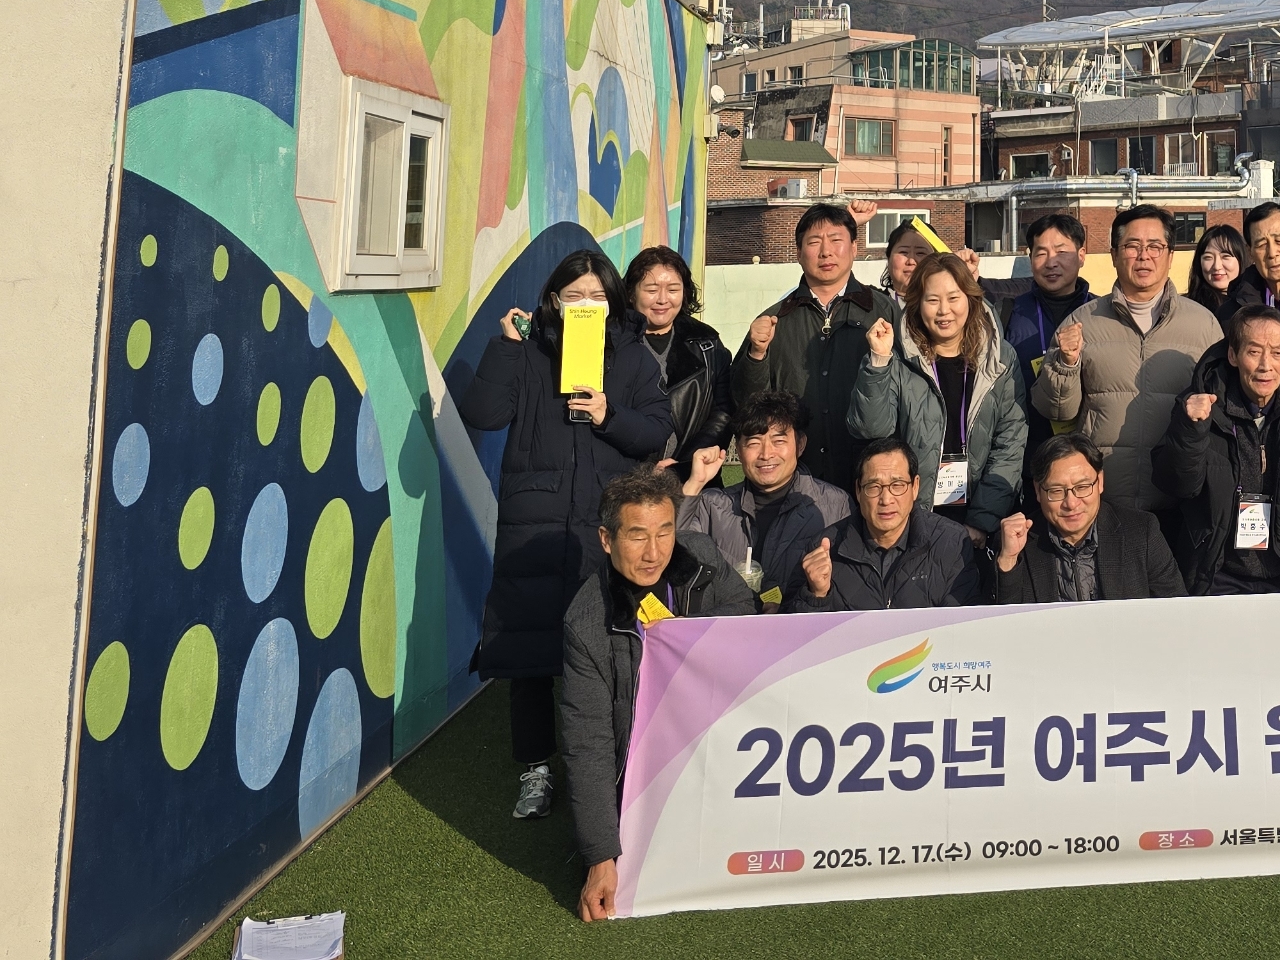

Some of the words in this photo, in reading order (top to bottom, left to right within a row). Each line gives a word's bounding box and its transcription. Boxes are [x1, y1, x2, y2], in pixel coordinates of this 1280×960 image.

[931, 661, 961, 672] 행복도시
[928, 673, 992, 694] 여주시
[733, 716, 1006, 799] 2025년
[1033, 706, 1240, 783] 여주시
[812, 849, 873, 870] 2025.
[878, 846, 906, 865] 12.
[981, 838, 1043, 859] 09:00
[1063, 834, 1121, 855] 18:00
